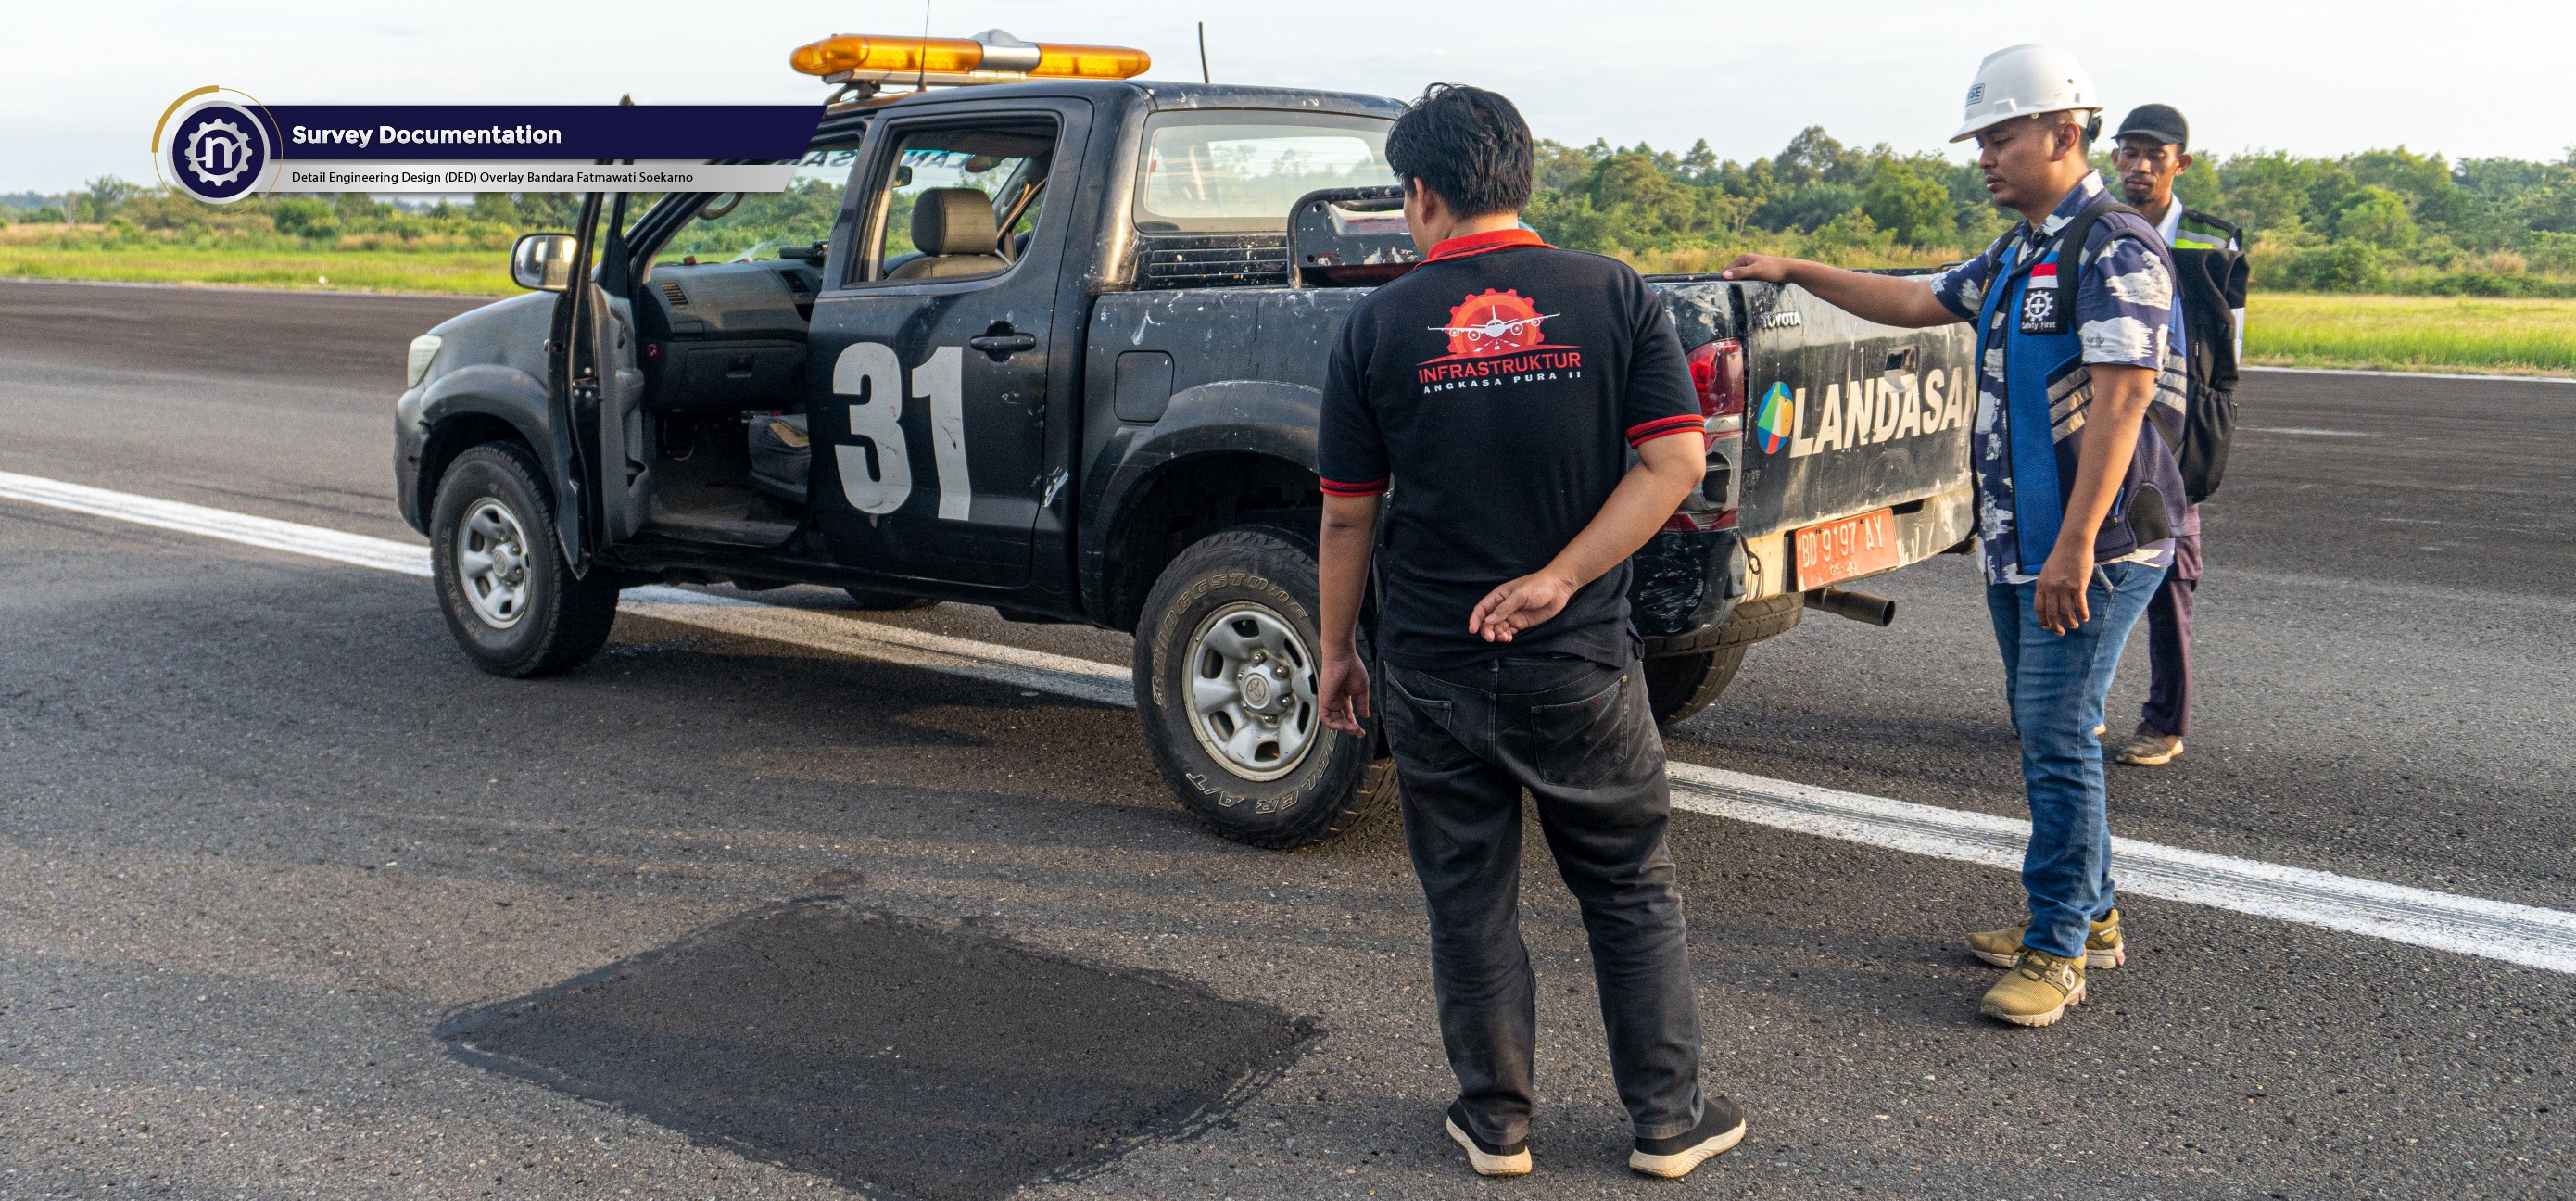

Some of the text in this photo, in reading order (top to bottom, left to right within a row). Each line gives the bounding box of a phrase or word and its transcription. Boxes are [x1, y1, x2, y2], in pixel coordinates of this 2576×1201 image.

[1760, 311, 1802, 328] TOYOTA
[2021, 322, 2039, 330] Safety
[1419, 351, 1582, 385] INFRASTRUKTUR
[1423, 371, 1582, 394] ANGKASA PURA II
[833, 342, 970, 520] 31
[1801, 515, 1883, 567] BD 9197 AY
[1152, 572, 1308, 710] BRIDGESTONE
[1186, 727, 1338, 814] UELER A/T
